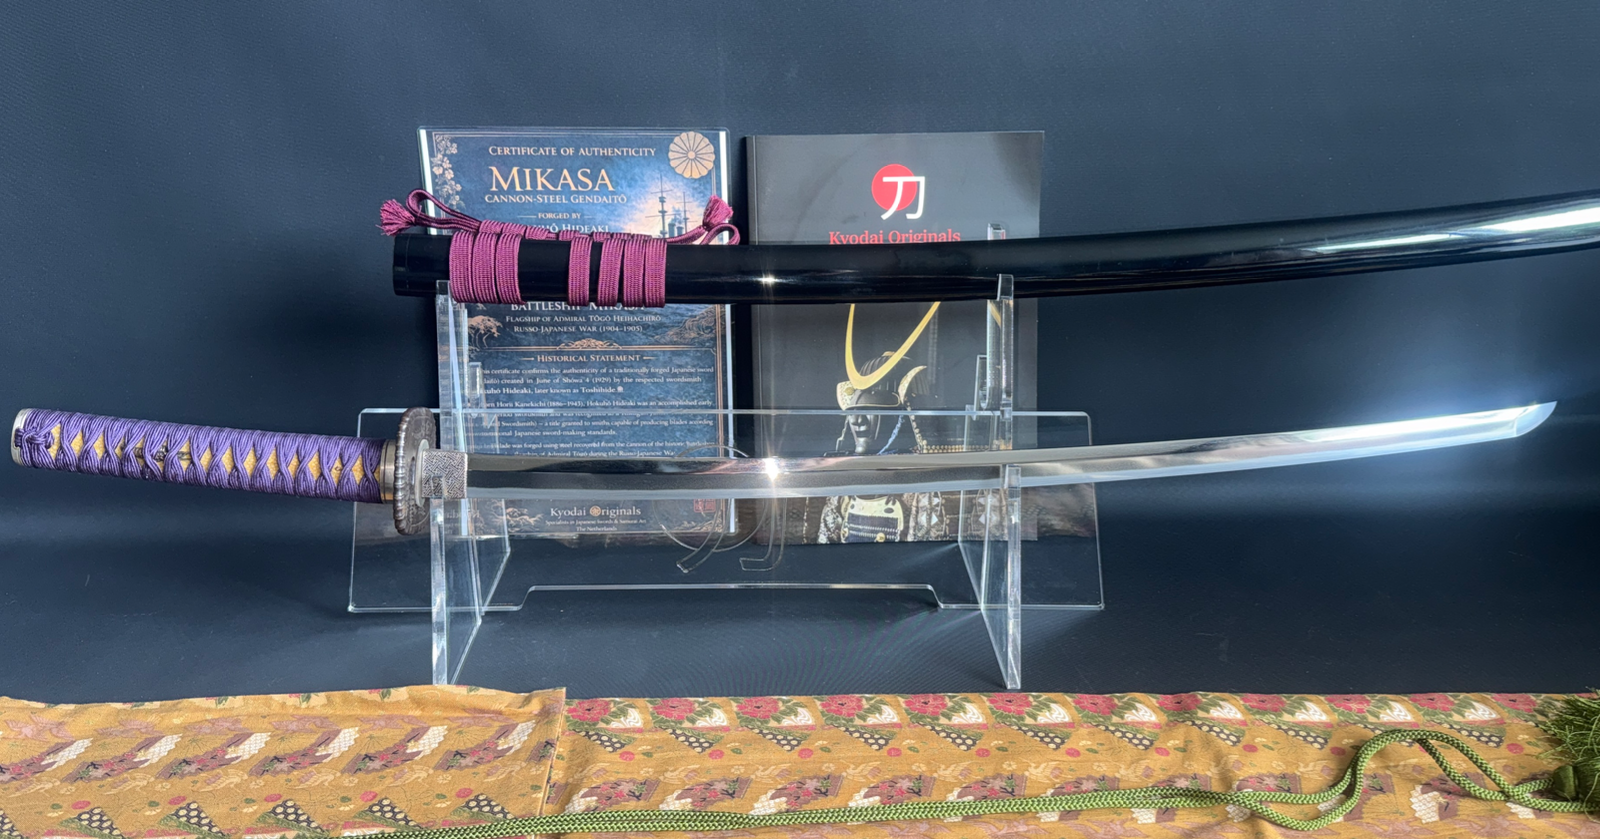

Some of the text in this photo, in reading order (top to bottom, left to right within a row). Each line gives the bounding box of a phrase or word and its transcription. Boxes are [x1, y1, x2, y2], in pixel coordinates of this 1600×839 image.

[489, 146, 656, 156] CERTIFICATE OF AUTHENTICITY
[488, 166, 615, 191] MIKASA
[484, 194, 568, 203] CANNON-STEEL
[880, 176, 925, 221] 刀
[562, 223, 609, 233] HIDEAKI
[829, 228, 961, 245] Kyodai Originals
[506, 315, 541, 323] FLAGSHIP
[513, 325, 576, 333] RUSSO-JAPANESE
[537, 354, 640, 362] HISTORICAL STATEMENT
[562, 367, 599, 375] authenticity
[613, 366, 649, 374] traditionally
[650, 366, 670, 374] forged
[671, 366, 696, 374] Japanese
[635, 376, 664, 384] respected
[550, 506, 587, 519] Kyodai
